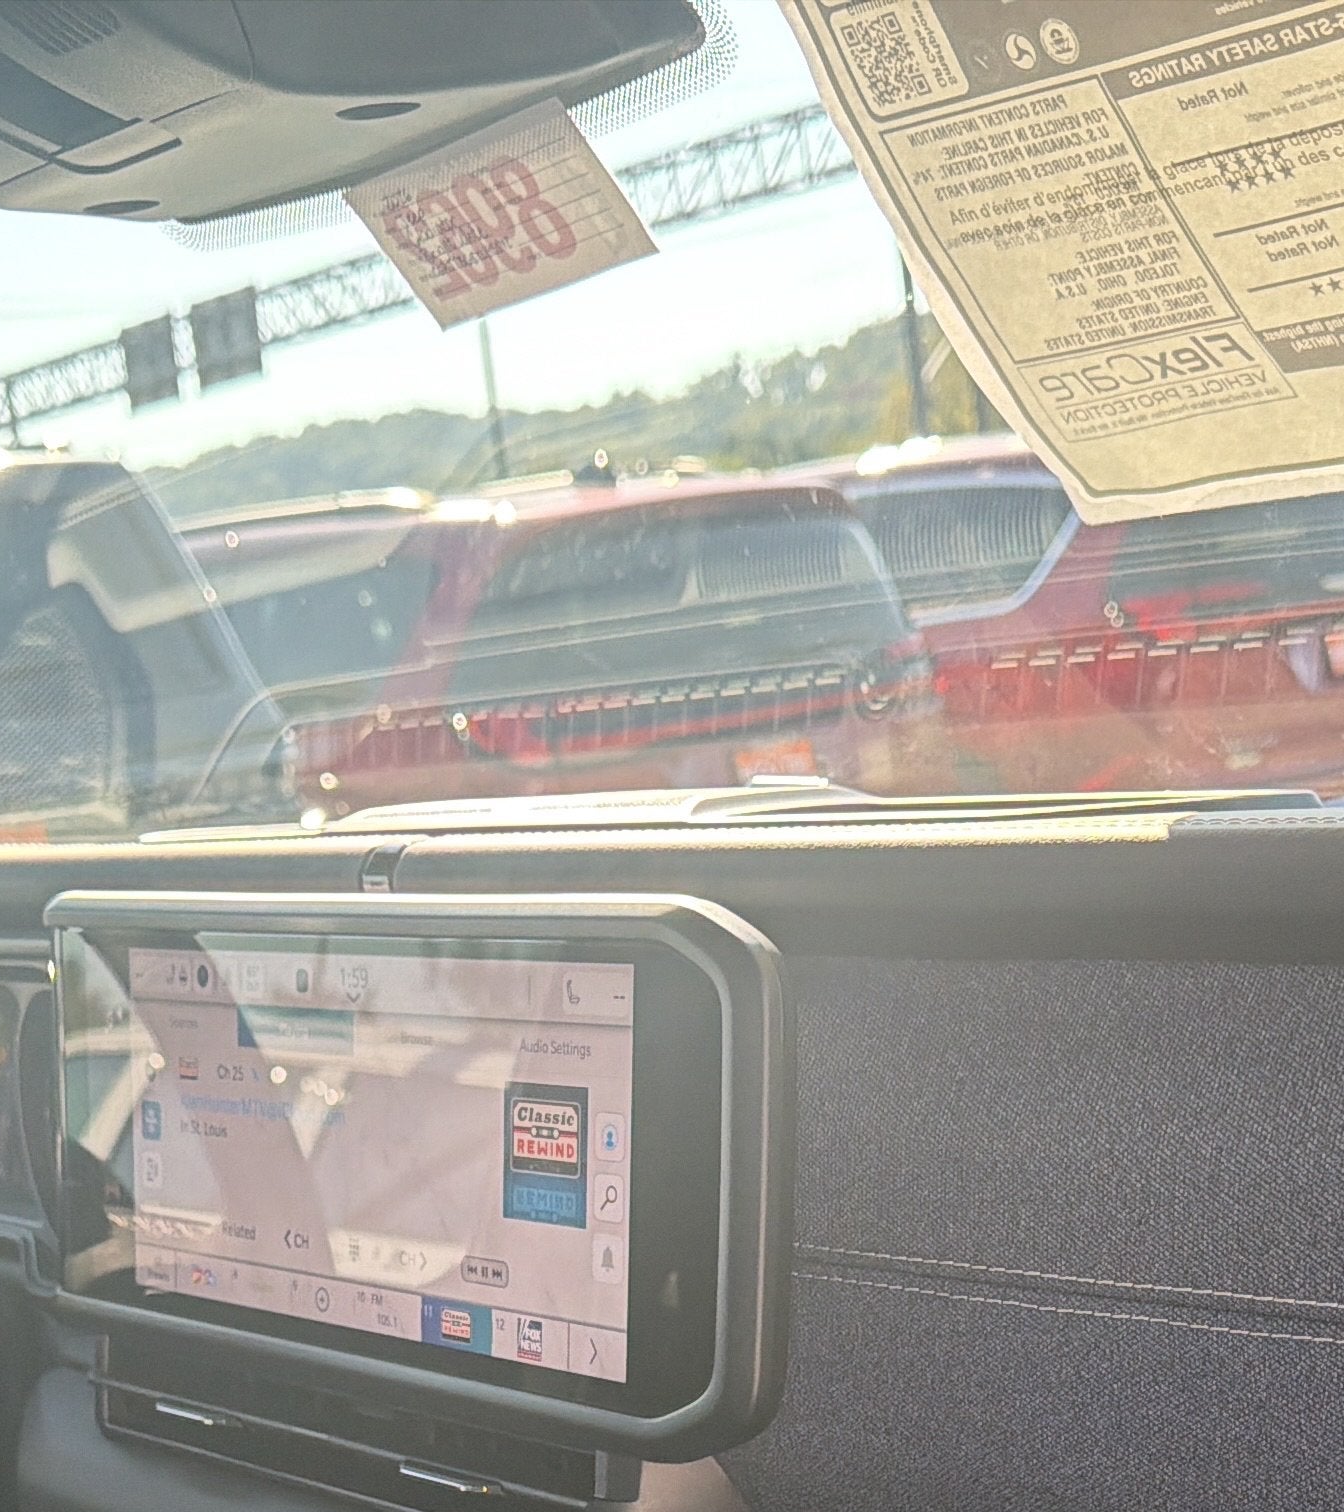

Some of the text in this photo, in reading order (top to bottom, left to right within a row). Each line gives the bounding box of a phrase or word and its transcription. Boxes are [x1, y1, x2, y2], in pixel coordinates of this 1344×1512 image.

[948, 196, 1031, 226] Afin d'éviter
[339, 967, 369, 989] 1:59
[519, 1038, 592, 1061] Audio Settings
[216, 1063, 245, 1081] Ch 25
[517, 1105, 575, 1127] Classic
[516, 1137, 575, 1160] REWIND
[221, 1221, 257, 1241] Related
[293, 1234, 310, 1250] CH
[398, 1250, 417, 1267] CH
[376, 1313, 399, 1329] 105.1
[495, 1317, 505, 1331] 12
[525, 1328, 542, 1342] FOX
[520, 1340, 543, 1353] NEWS
